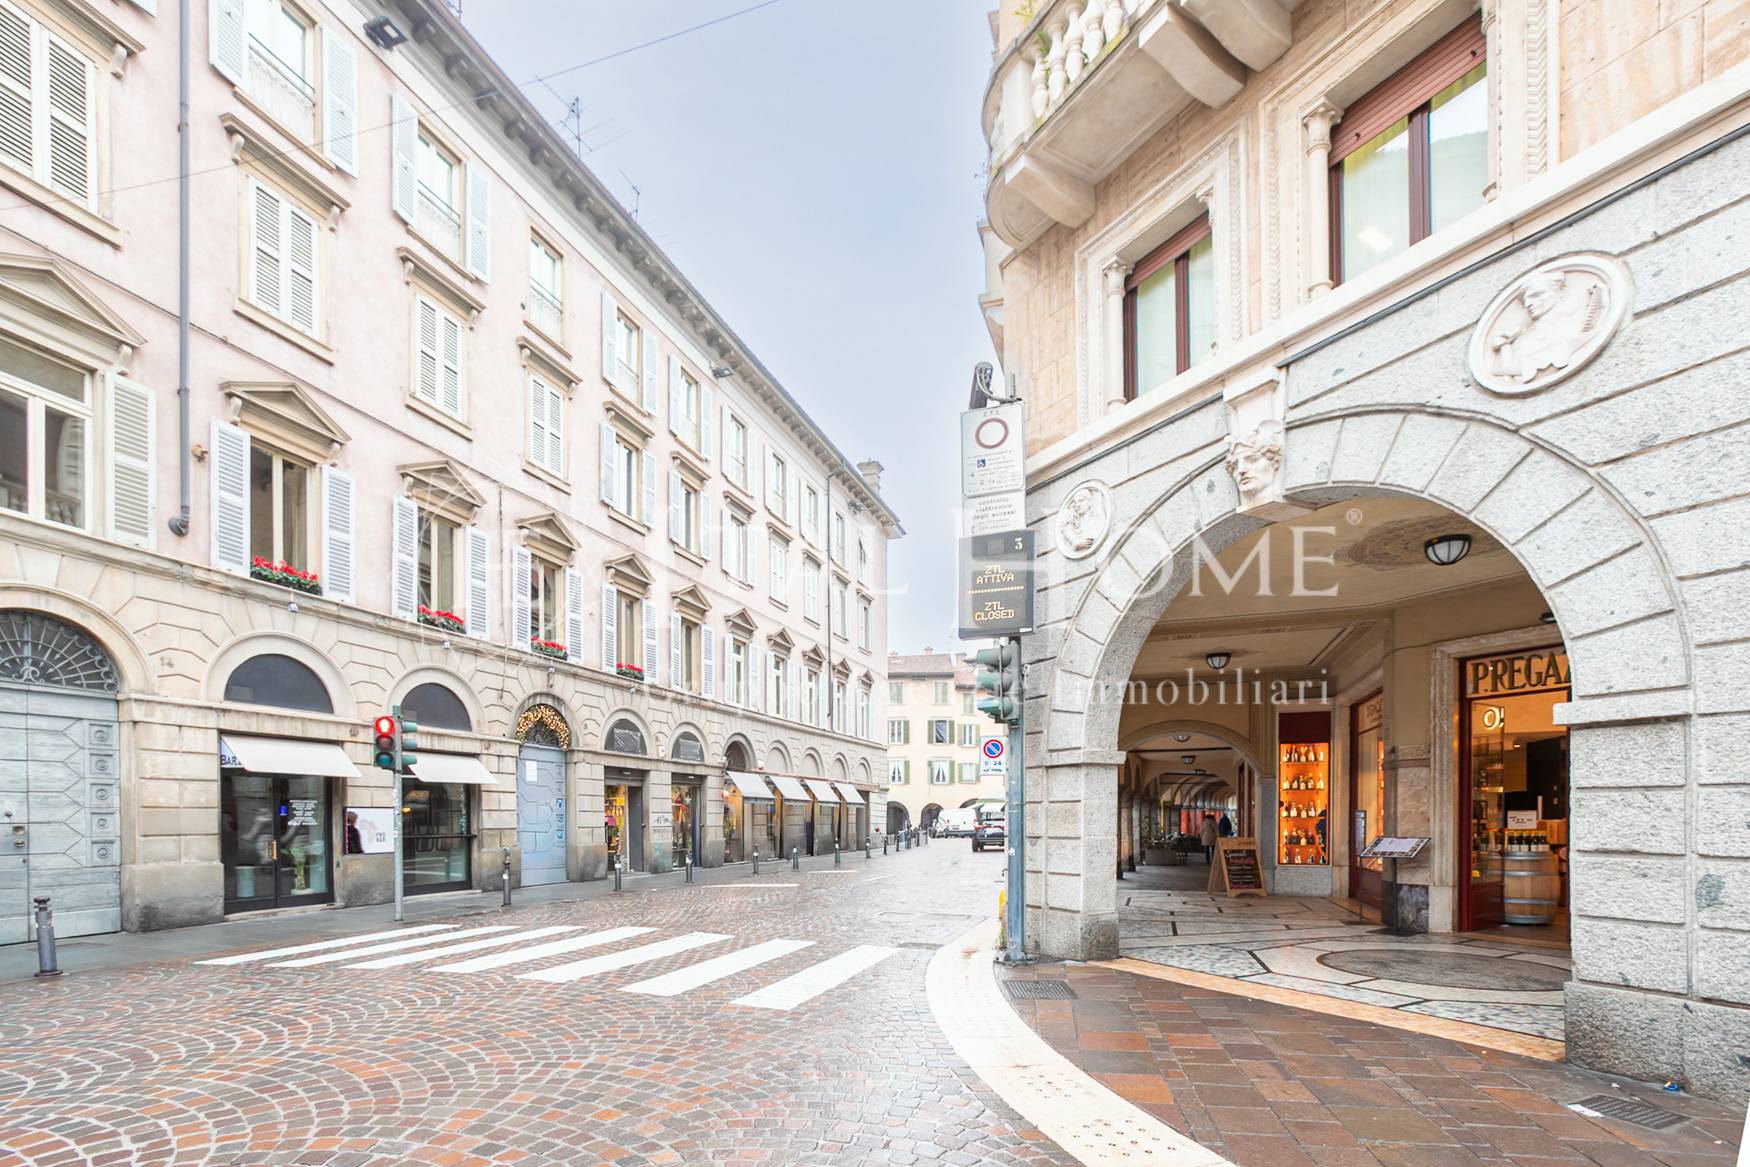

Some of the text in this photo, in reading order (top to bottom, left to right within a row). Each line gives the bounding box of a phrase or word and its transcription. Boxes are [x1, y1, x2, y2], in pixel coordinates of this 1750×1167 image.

[1014, 537, 1023, 550] 3
[985, 564, 1005, 574] ZTL
[976, 572, 1015, 584] ATTIVA
[984, 601, 1005, 611] ZTL
[974, 609, 1015, 621] CLOSED
